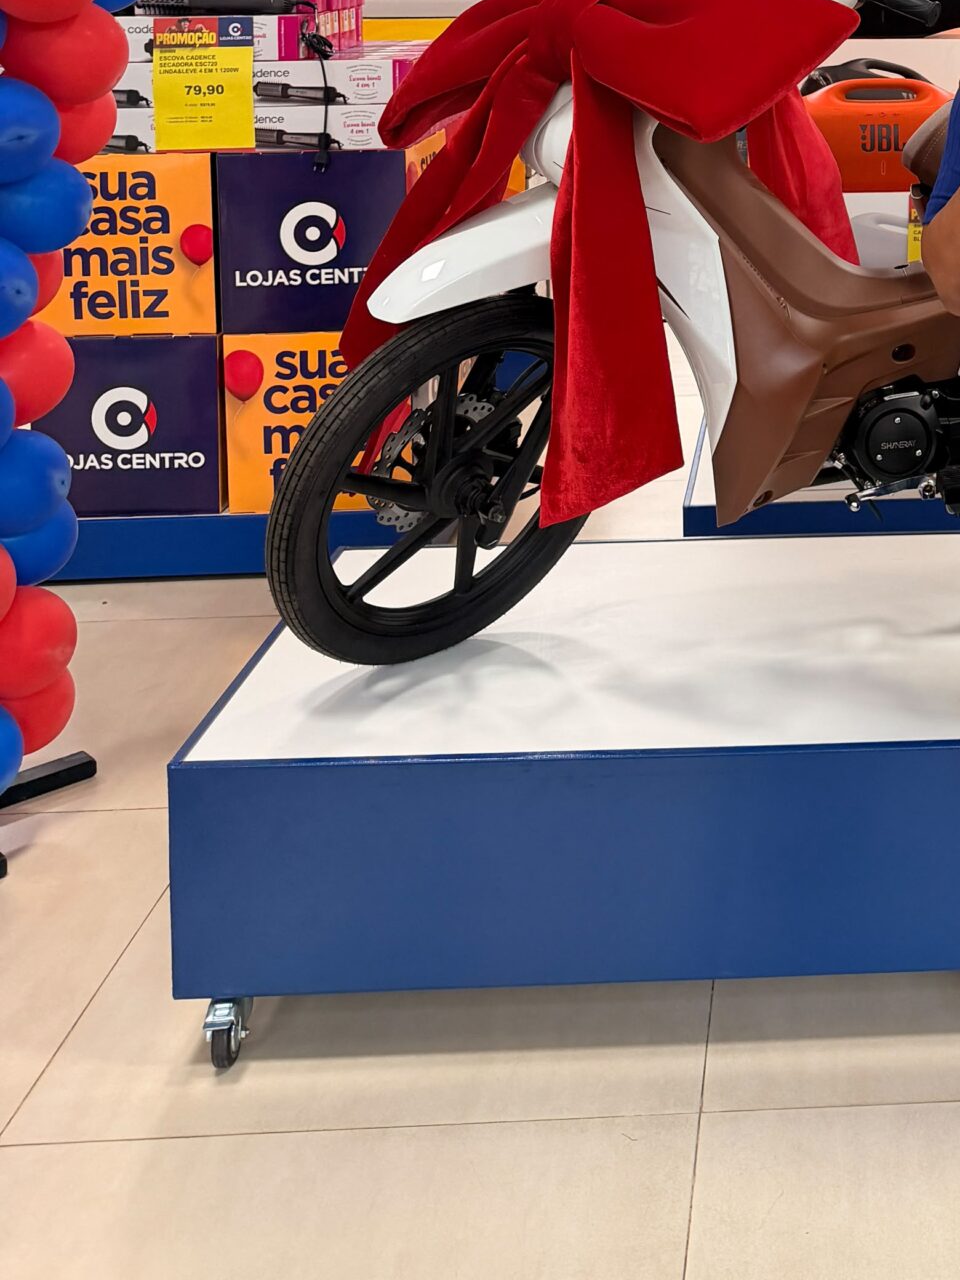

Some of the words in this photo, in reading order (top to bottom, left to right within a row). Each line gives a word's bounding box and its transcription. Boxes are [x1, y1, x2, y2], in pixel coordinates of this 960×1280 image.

[156, 28, 217, 47] PROMOÇÃO
[184, 84, 225, 97] 79,90
[253, 114, 285, 124] dence
[860, 124, 906, 152] JBL
[80, 205, 170, 236] asa
[63, 236, 175, 277] mais
[235, 270, 302, 287] LOJAS
[305, 267, 368, 285] CENT
[70, 279, 170, 320] feliz
[275, 350, 349, 380] sua
[117, 451, 206, 470] CENTRO
